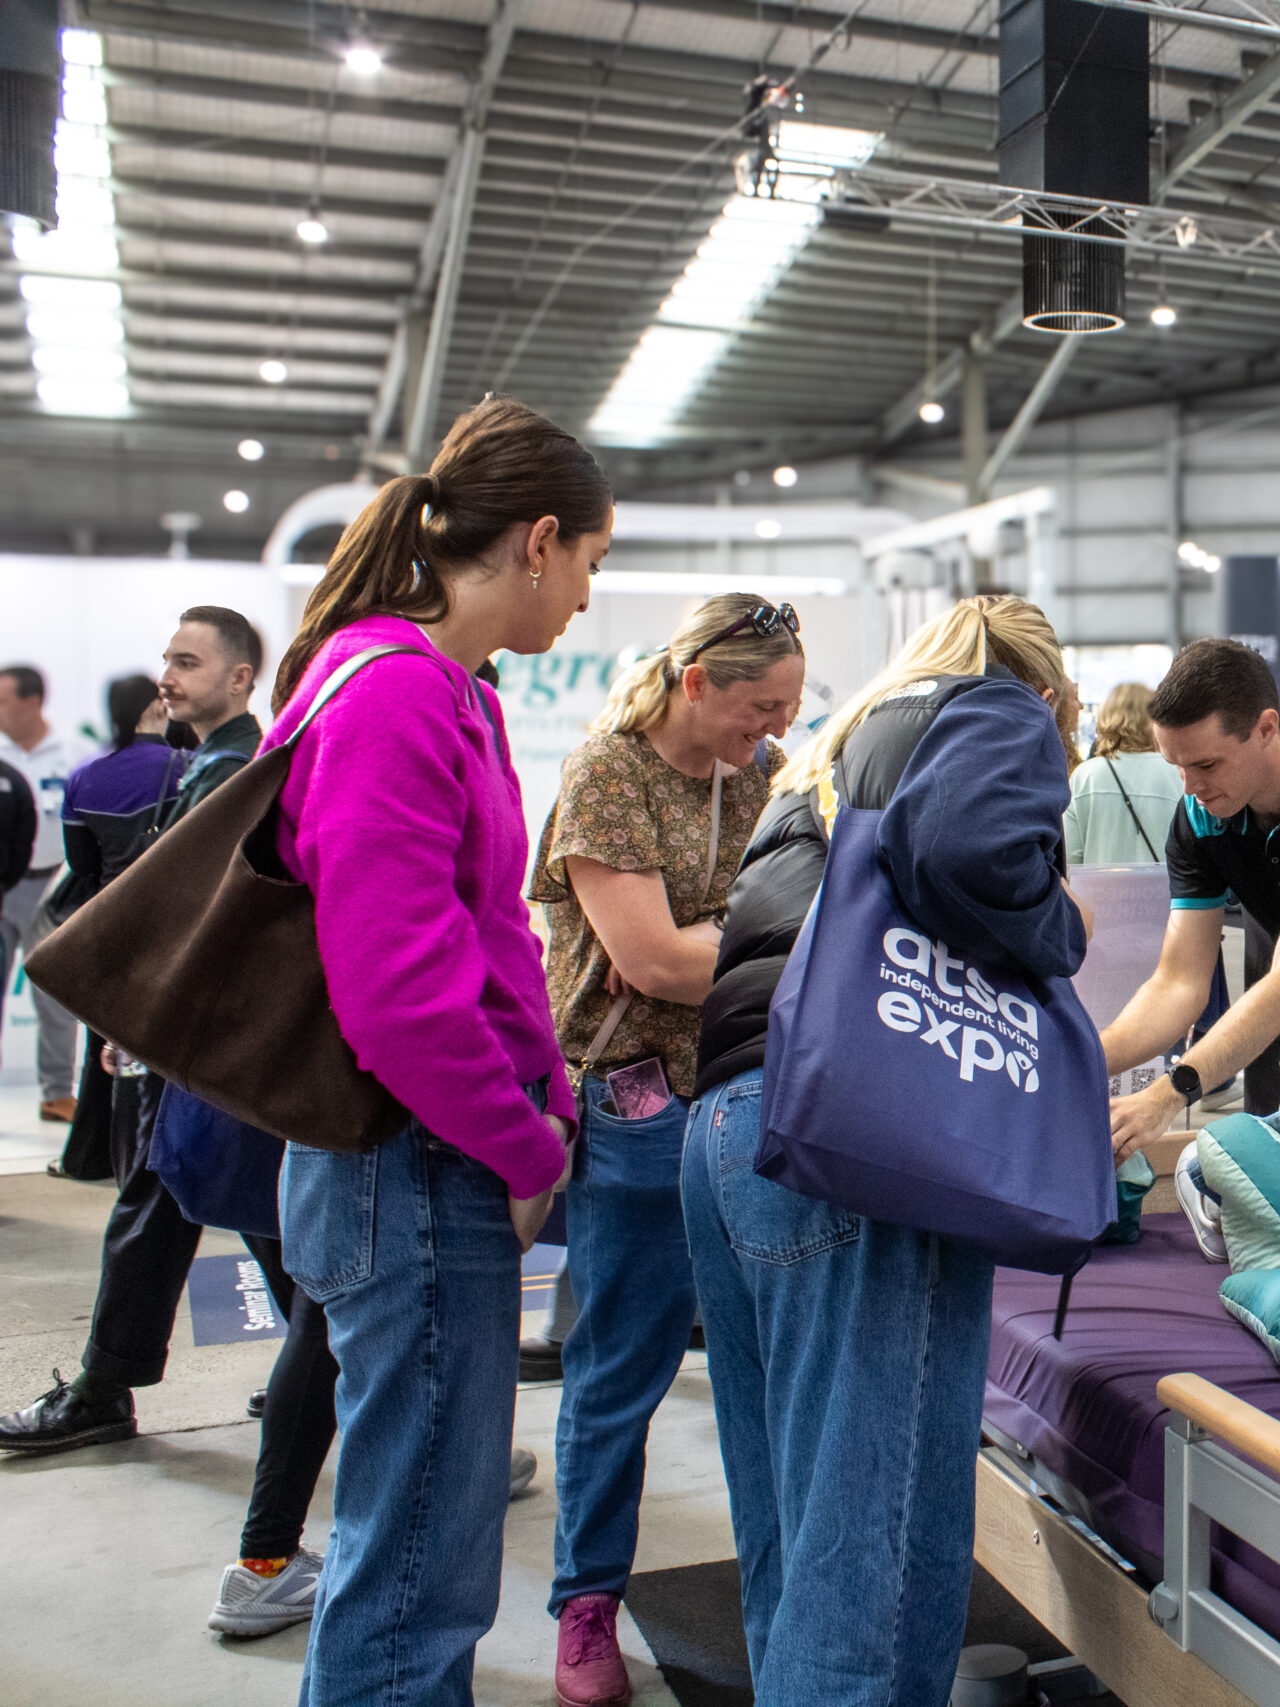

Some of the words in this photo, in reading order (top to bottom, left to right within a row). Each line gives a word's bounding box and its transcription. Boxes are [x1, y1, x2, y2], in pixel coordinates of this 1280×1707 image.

[879, 963, 995, 1029] independent
[997, 1020, 1039, 1060] living
[883, 927, 1039, 1041] atsa
[877, 991, 1040, 1093] expo
[235, 1260, 266, 1291] Rooms
[238, 1291, 276, 1331] Seminar
